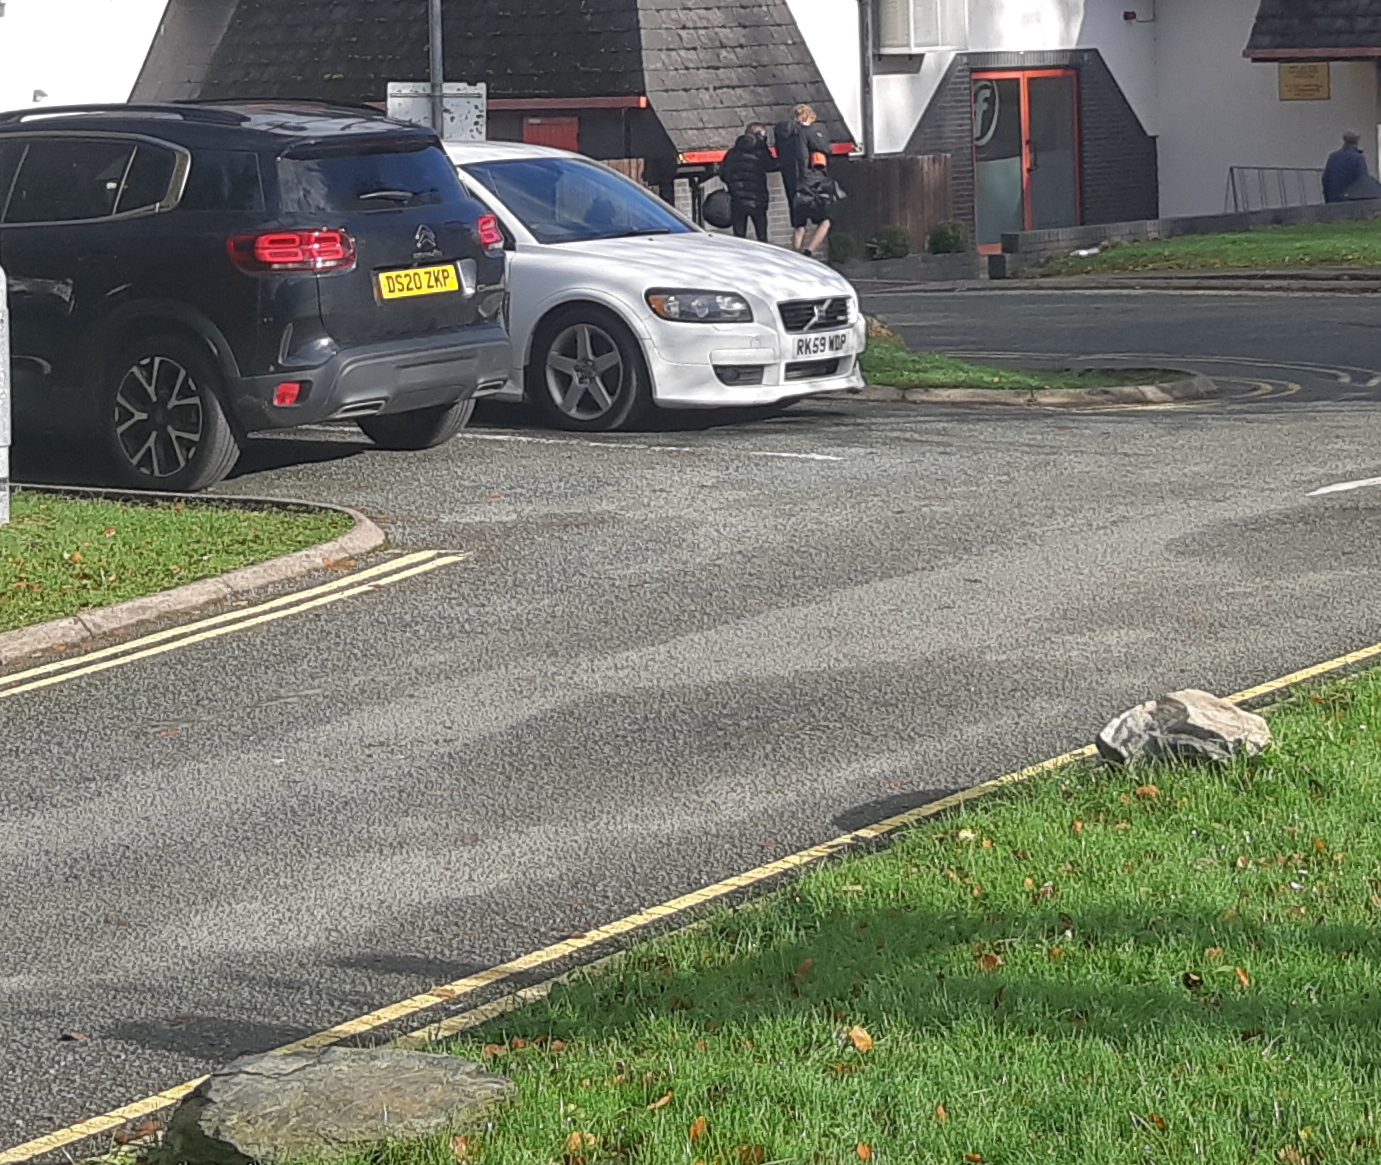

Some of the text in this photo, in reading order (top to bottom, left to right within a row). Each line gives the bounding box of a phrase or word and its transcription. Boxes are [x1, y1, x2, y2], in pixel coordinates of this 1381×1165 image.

[386, 269, 449, 293] DS20 ZKP
[797, 337, 826, 355] RK59
